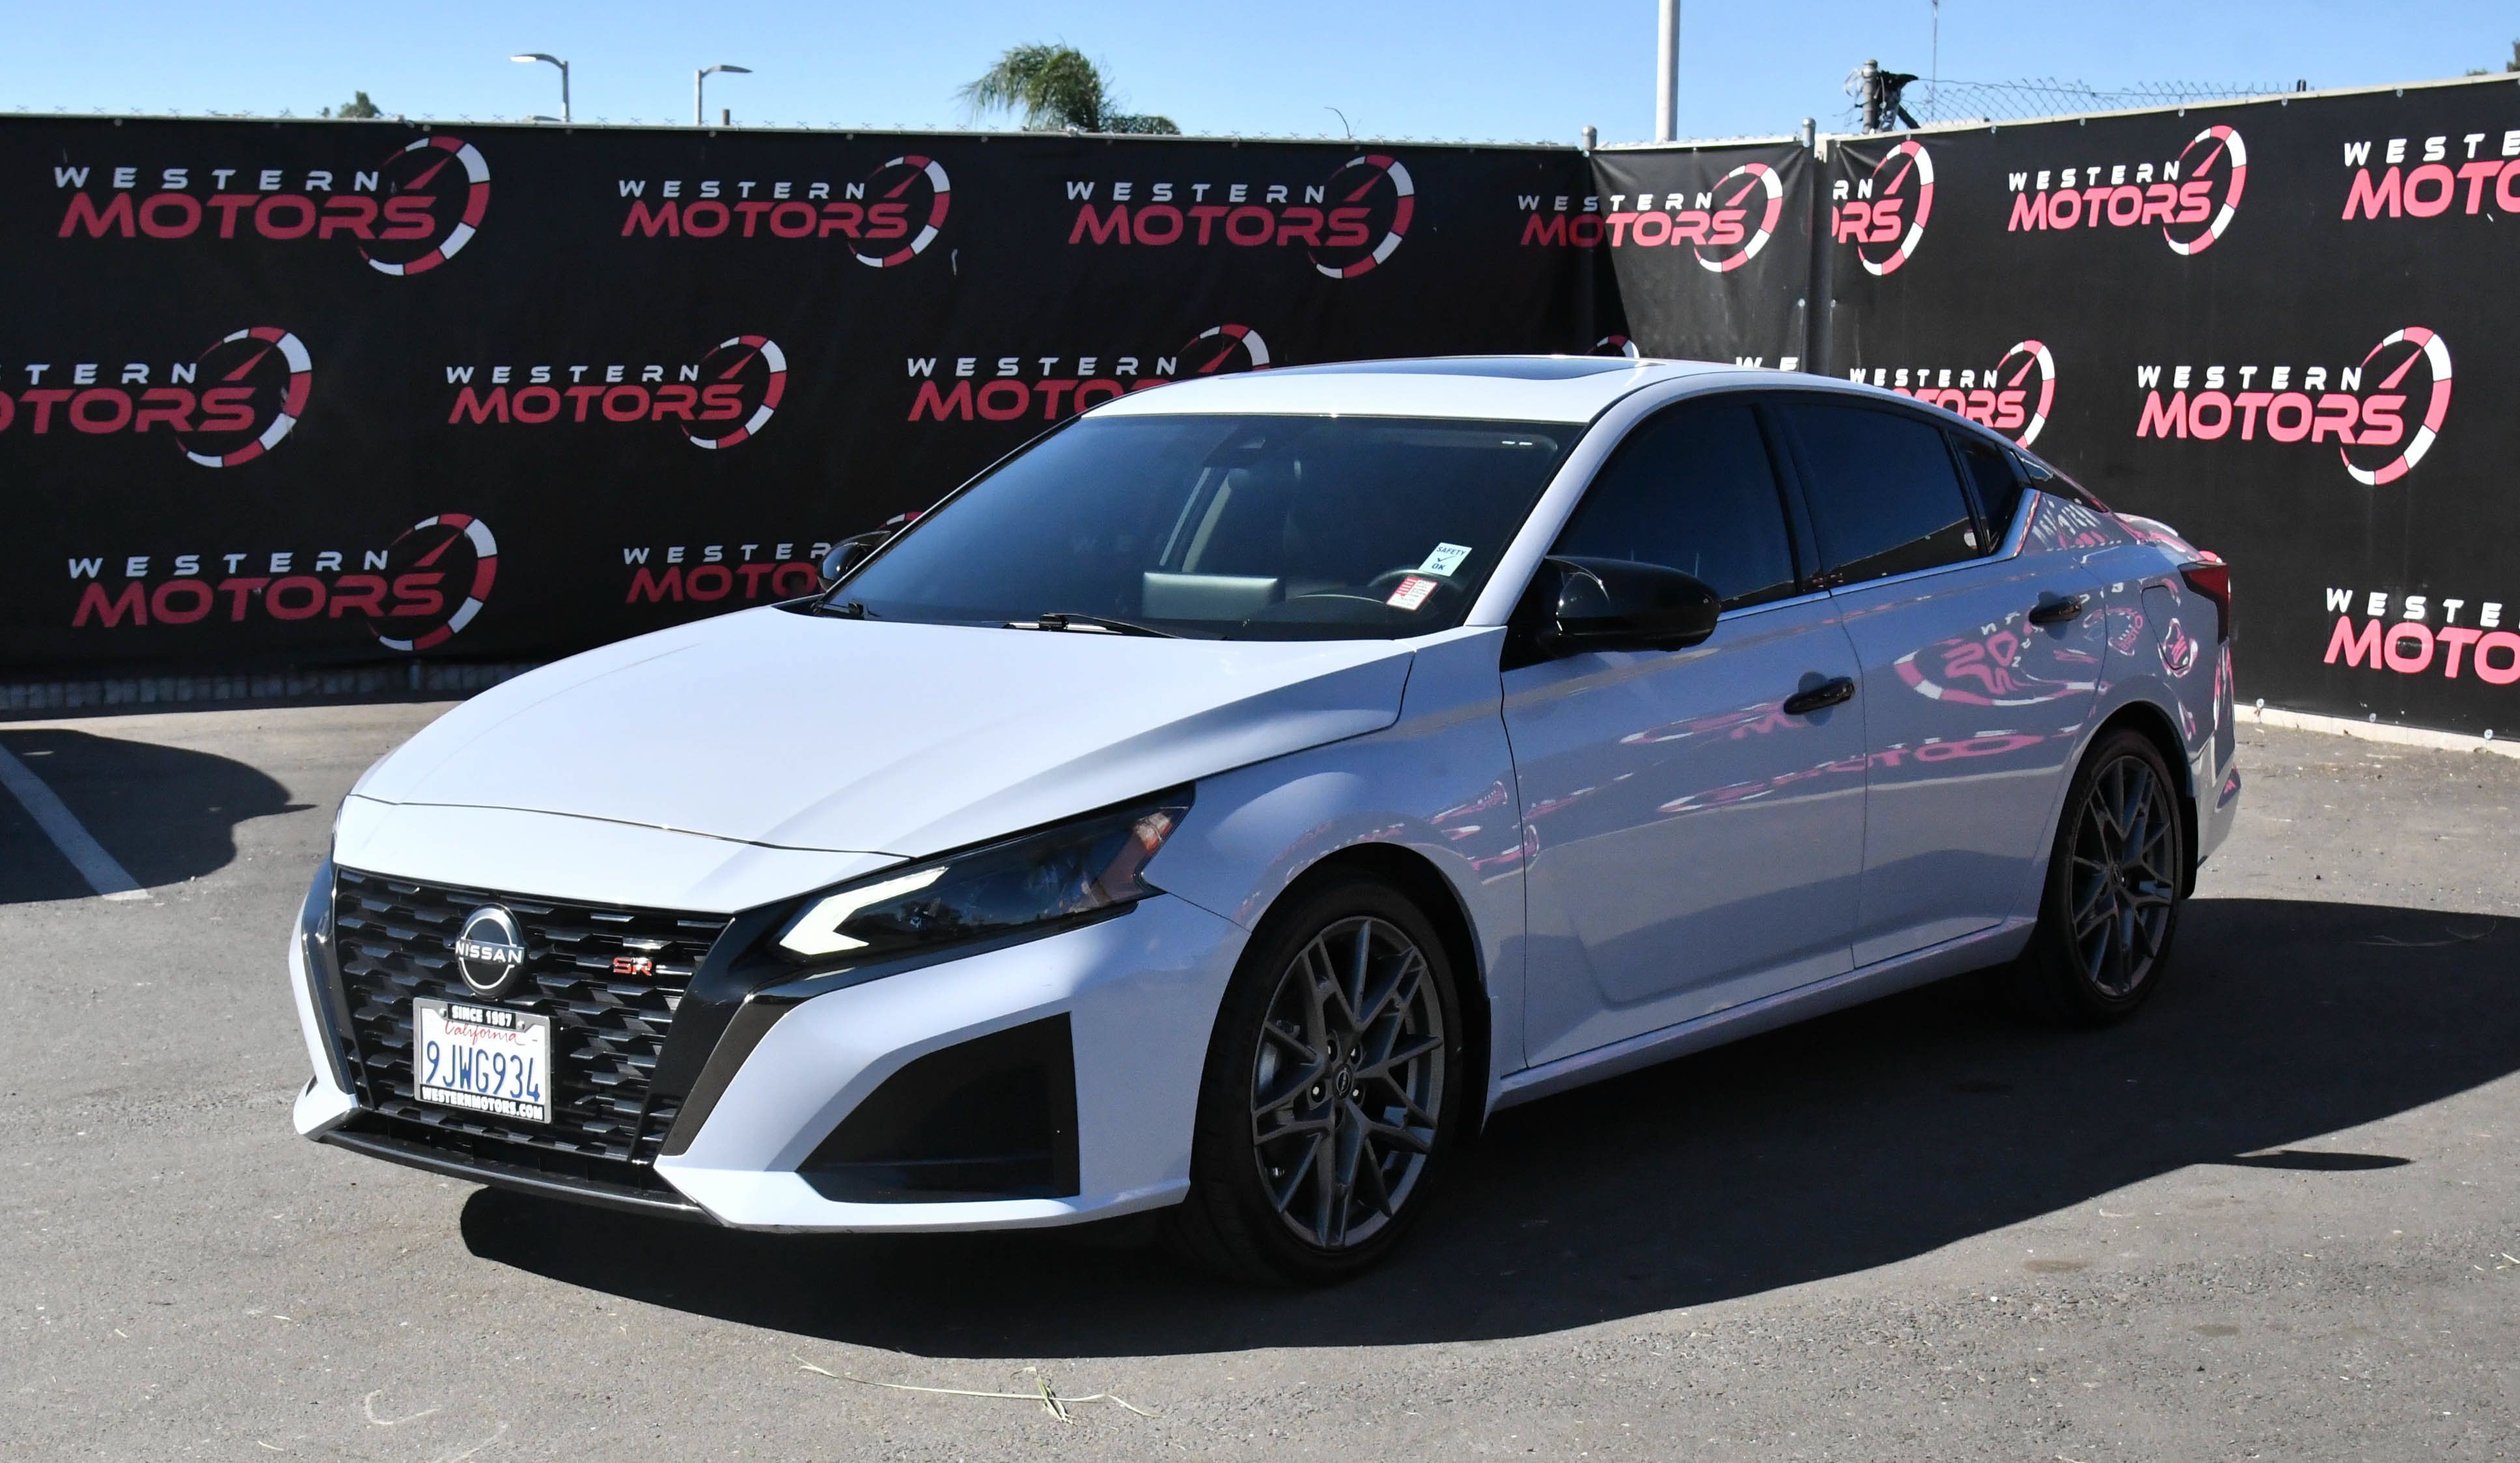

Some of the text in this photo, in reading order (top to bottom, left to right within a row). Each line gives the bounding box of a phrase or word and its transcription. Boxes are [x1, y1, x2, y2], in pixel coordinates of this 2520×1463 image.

[2344, 130, 2520, 167] WESTE
[55, 167, 378, 191] WESTERN
[619, 180, 865, 199] WESTERN
[2008, 160, 2180, 192] WESTERN
[1067, 182, 1324, 203] WESTERN
[1518, 191, 1713, 212] WESTERN
[2007, 183, 2213, 232] MOTORS
[59, 193, 436, 239] MOTORS
[621, 201, 909, 238] MOTORS
[1069, 204, 1371, 247] MOTORS
[1521, 209, 1747, 247] MOTORS
[1831, 198, 1904, 244] RS
[0, 363, 197, 385] TERN
[447, 365, 699, 384] WESTERN
[907, 357, 1177, 377] WESTERN
[1849, 368, 1999, 389] WESTERN
[2137, 366, 2362, 391] WESTERN
[0, 387, 256, 434] TORS
[448, 383, 744, 424] MOTORS
[907, 379, 1170, 421] MOTO
[2136, 390, 2407, 445] MOTORS
[68, 550, 389, 578] WESTERN
[1437, 546, 1466, 556] SAFETY
[73, 572, 445, 628] MOTORS
[2323, 615, 2520, 685] MOTO
[456, 941, 522, 964] NISSAN
[613, 957, 652, 977] SR
[452, 1005, 512, 1027] SINCE 1987
[445, 1020, 526, 1046] California
[426, 1040, 540, 1102] 9JWG934
[422, 1086, 544, 1121] WESTERNMOTORS.COM
